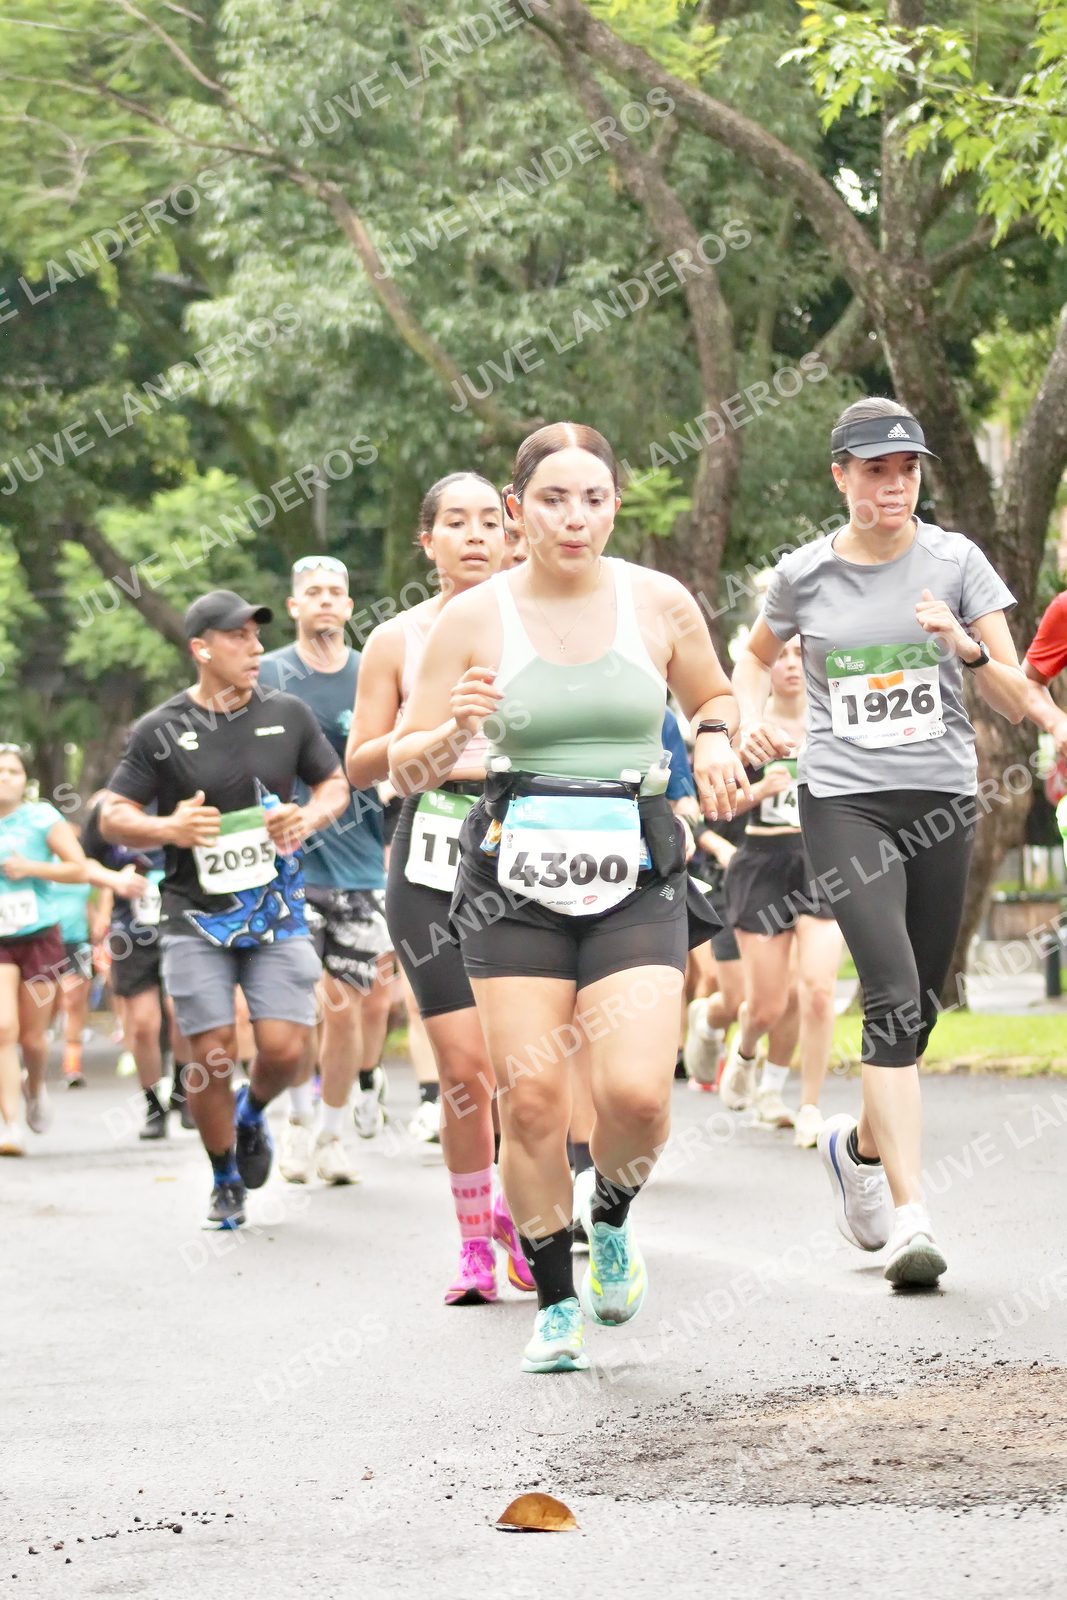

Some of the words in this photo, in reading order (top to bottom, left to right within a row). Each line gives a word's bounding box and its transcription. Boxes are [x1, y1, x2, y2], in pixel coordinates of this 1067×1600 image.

[842, 684, 934, 725] 1926
[204, 840, 274, 875] 2095
[509, 852, 628, 888] 4300
